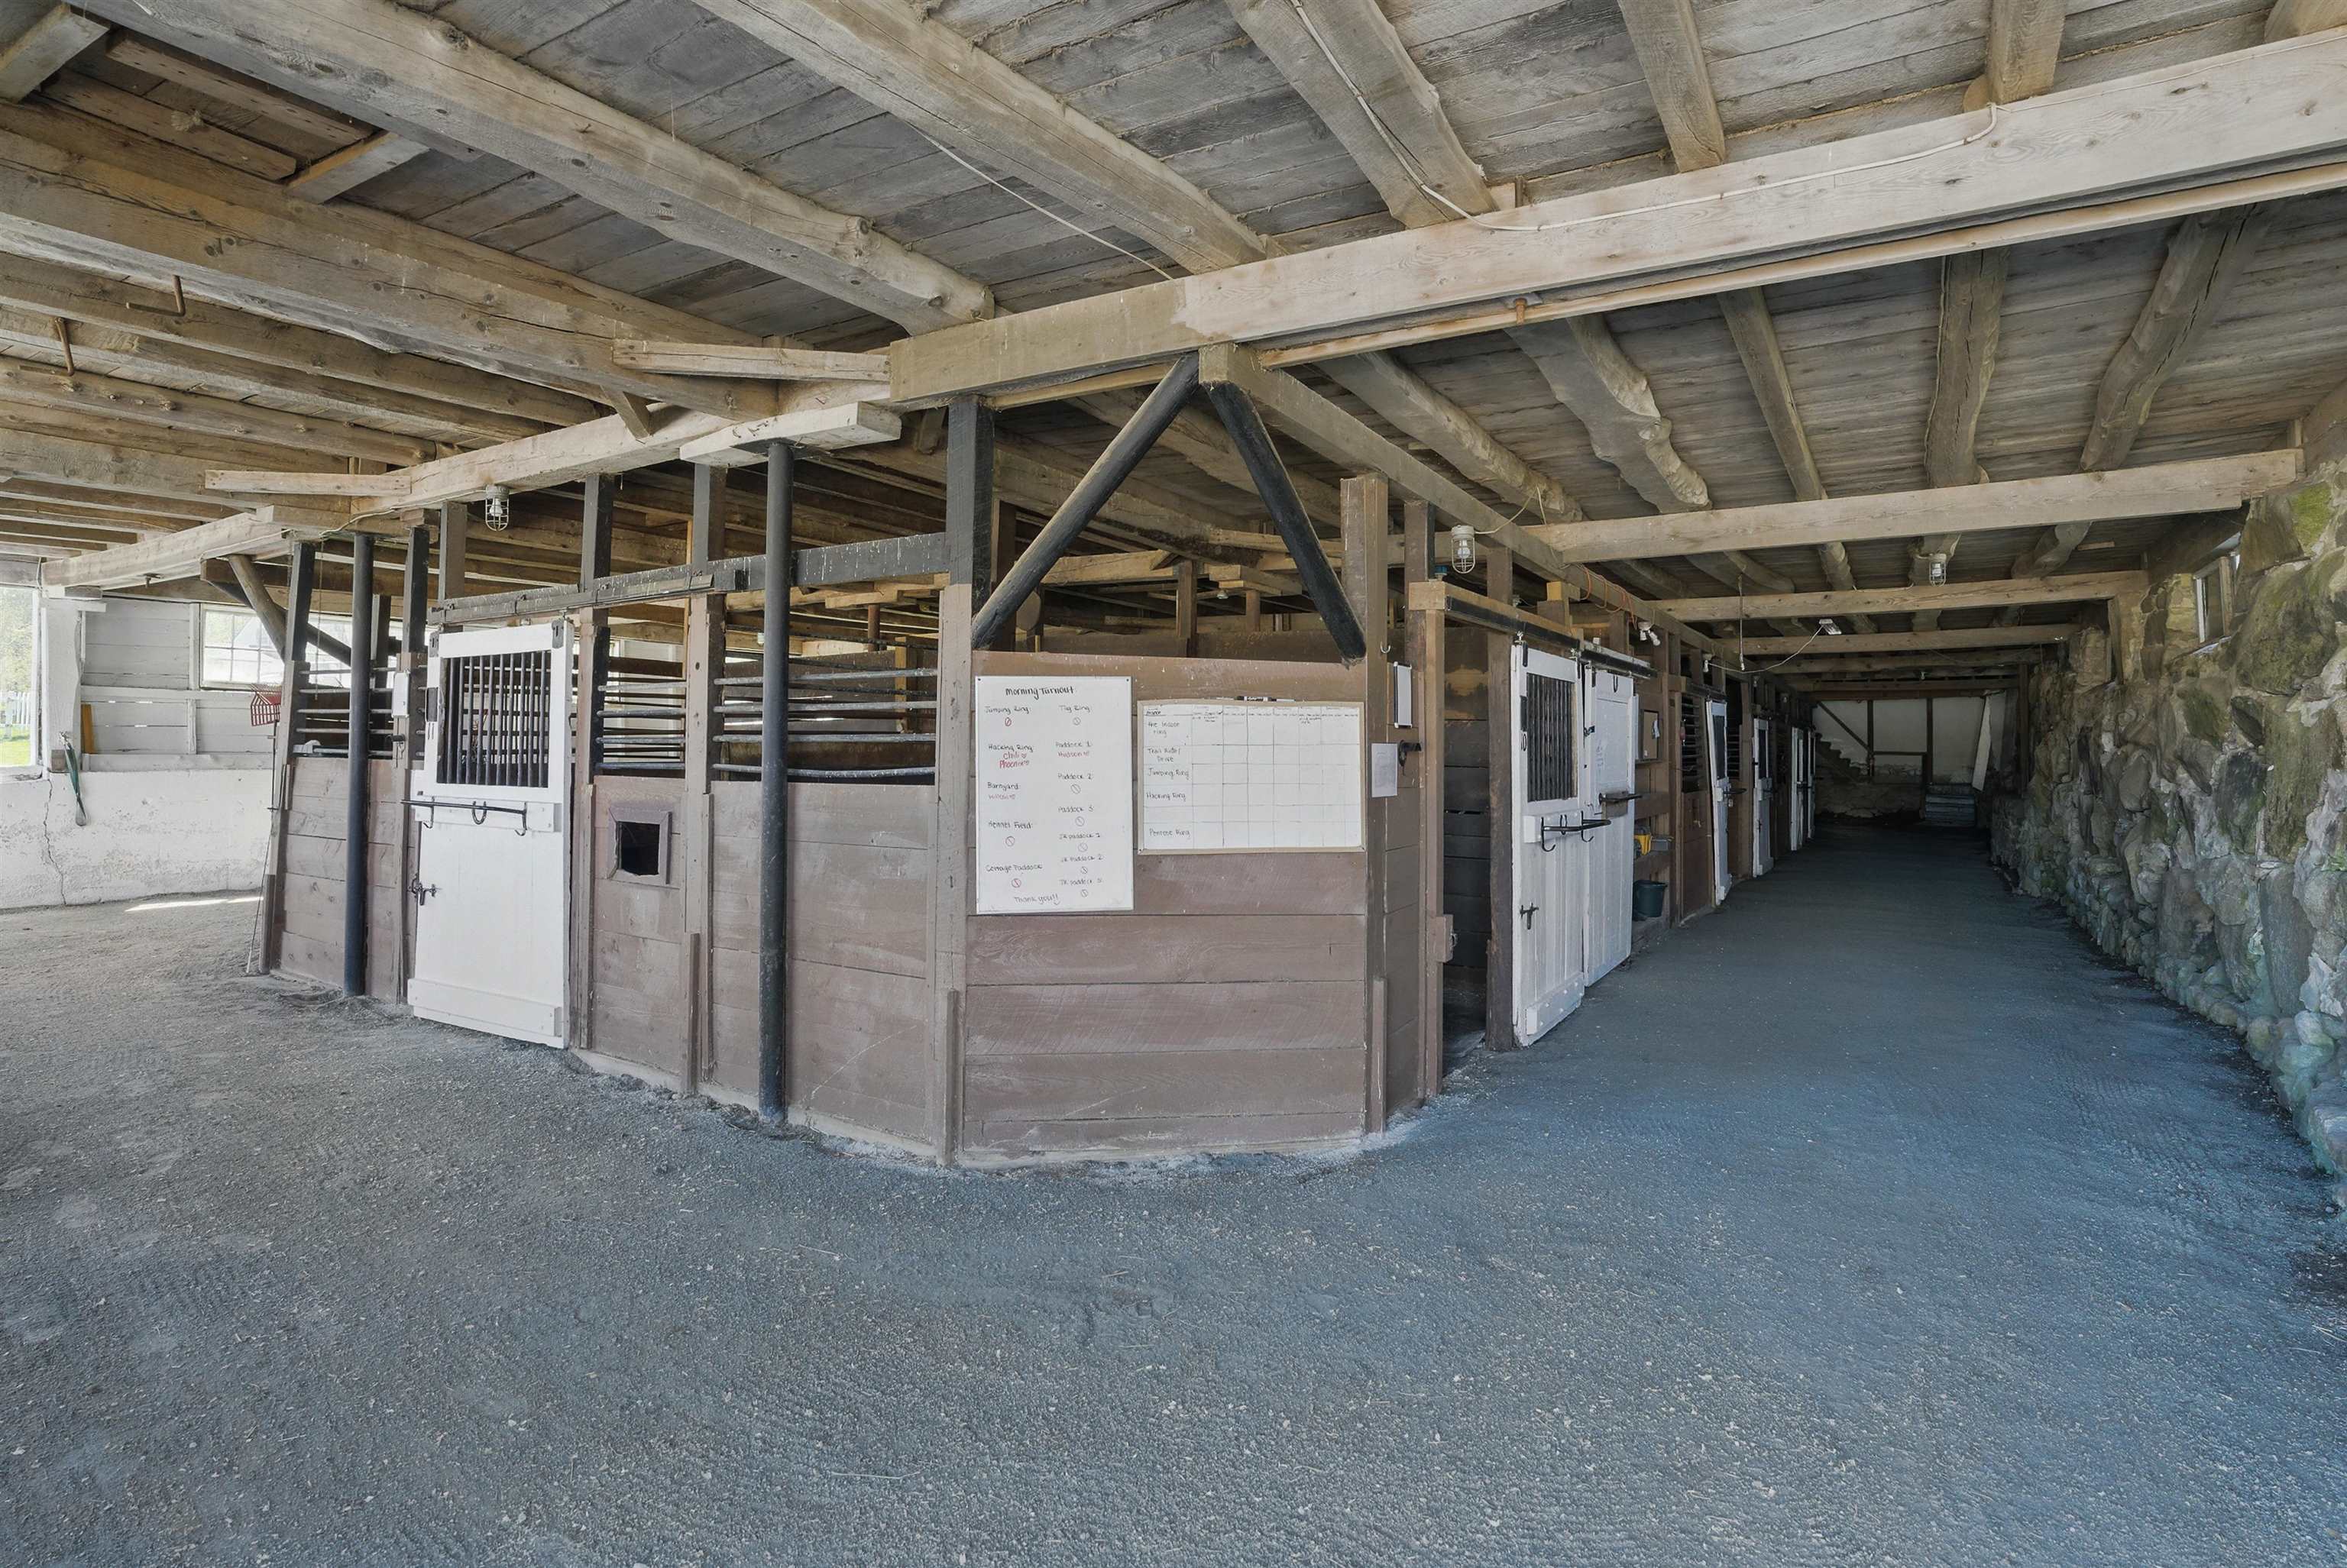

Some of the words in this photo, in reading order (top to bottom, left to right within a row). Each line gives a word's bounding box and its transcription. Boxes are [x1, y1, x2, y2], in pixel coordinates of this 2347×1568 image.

[1005, 687, 1039, 700] Morning
[1040, 687, 1075, 696] Turnout
[1014, 895, 1037, 904] Thank
